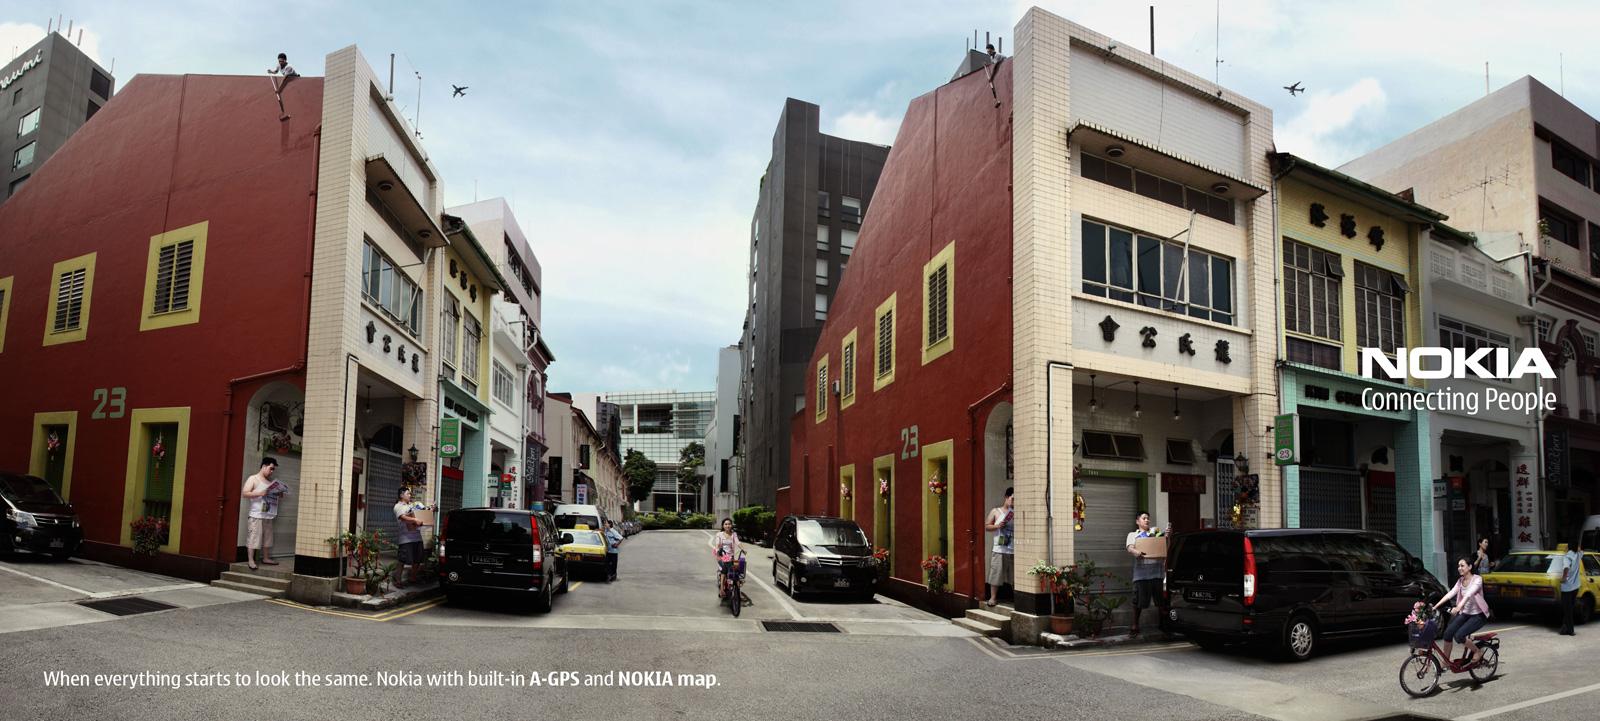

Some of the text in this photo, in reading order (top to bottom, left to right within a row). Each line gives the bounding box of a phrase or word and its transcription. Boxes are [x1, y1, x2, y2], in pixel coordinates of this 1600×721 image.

[91, 387, 127, 419] 23
[901, 424, 919, 460] 23
[1279, 450, 1290, 459] 23
